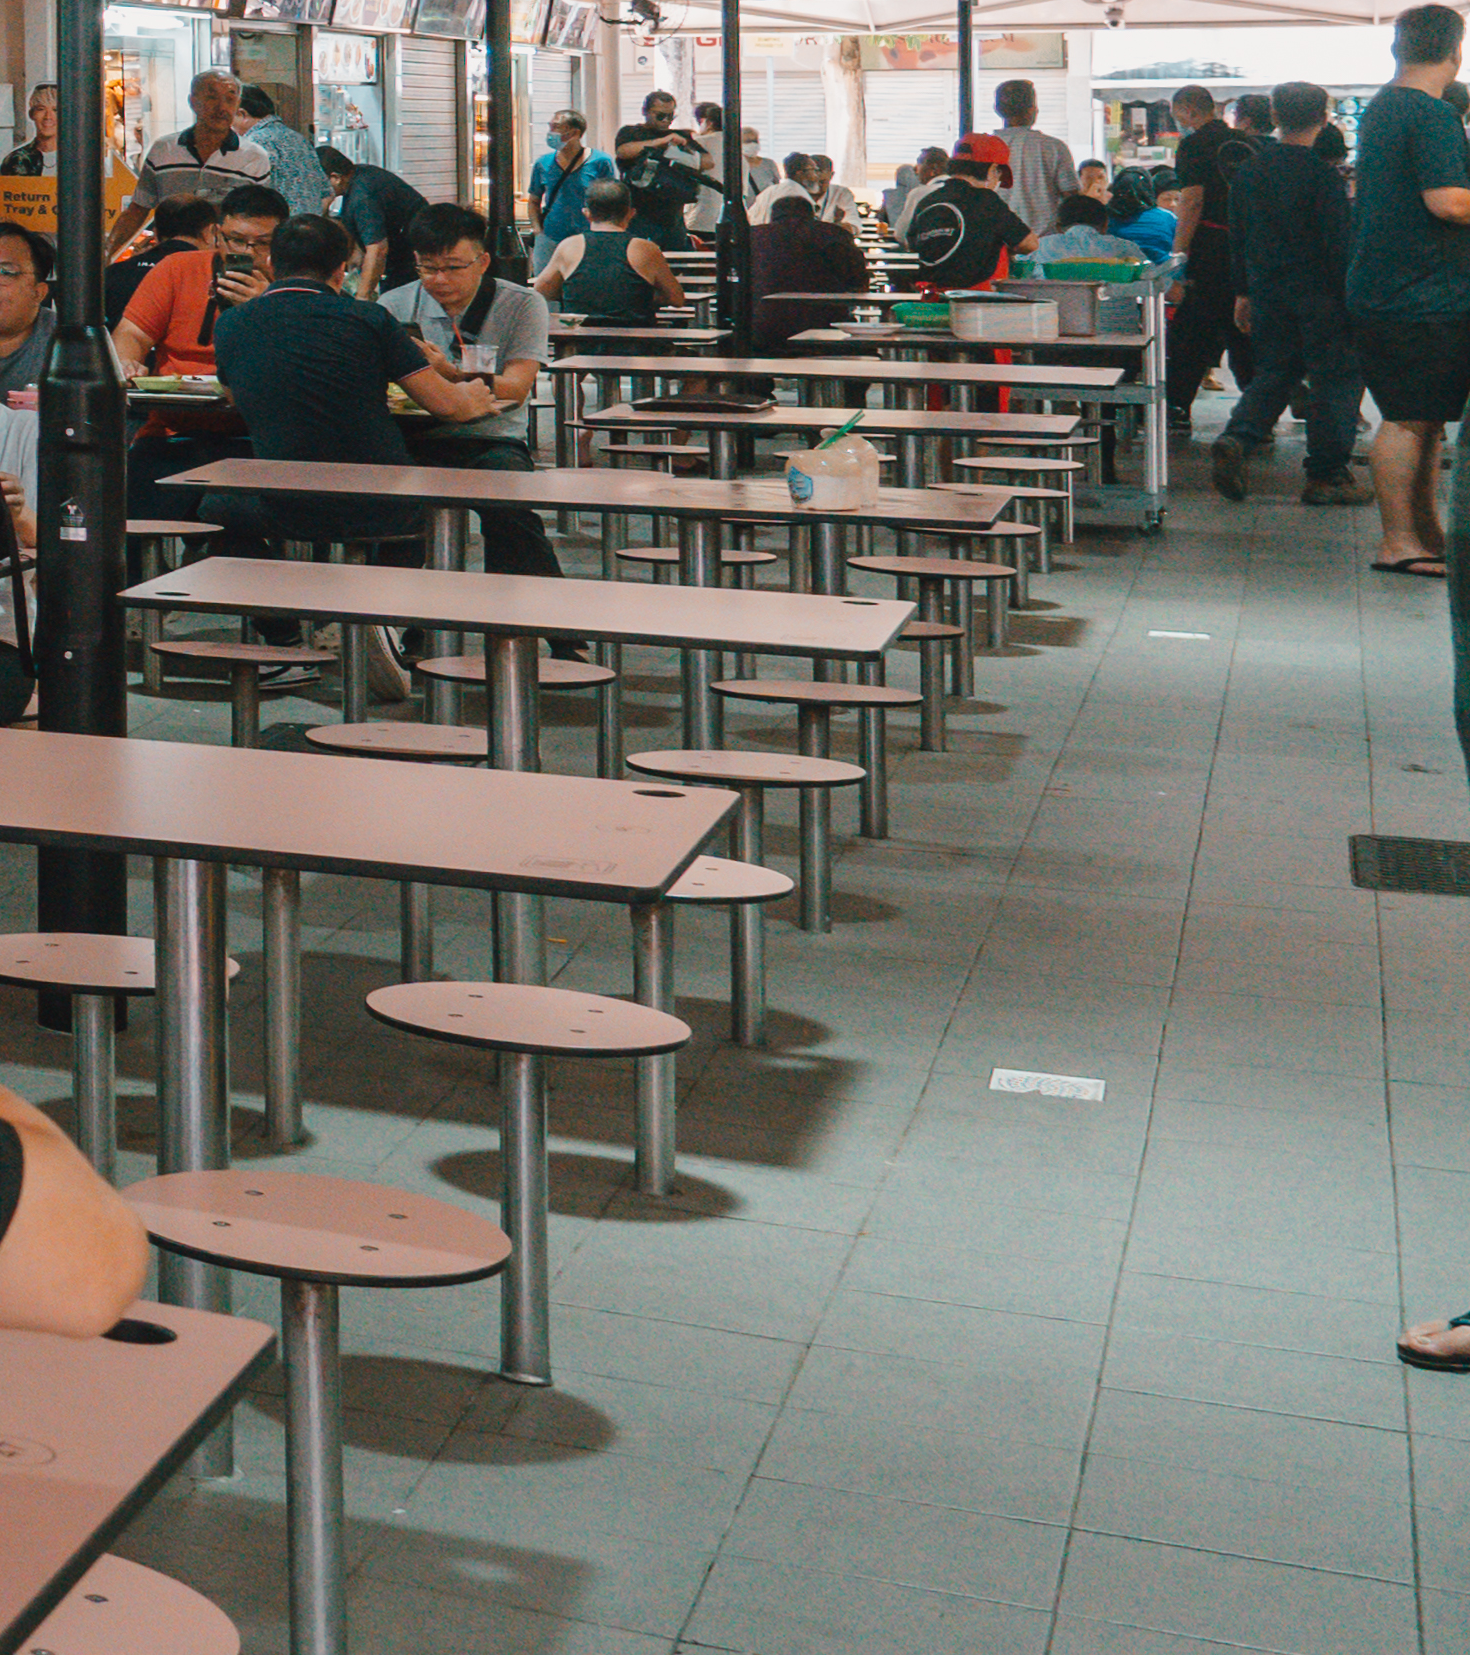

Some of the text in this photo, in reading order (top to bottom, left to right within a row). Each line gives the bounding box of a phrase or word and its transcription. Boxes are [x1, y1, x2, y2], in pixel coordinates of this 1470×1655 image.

[3, 191, 51, 202] Return
[4, 204, 35, 217] Tray
[38, 204, 47, 215] &
